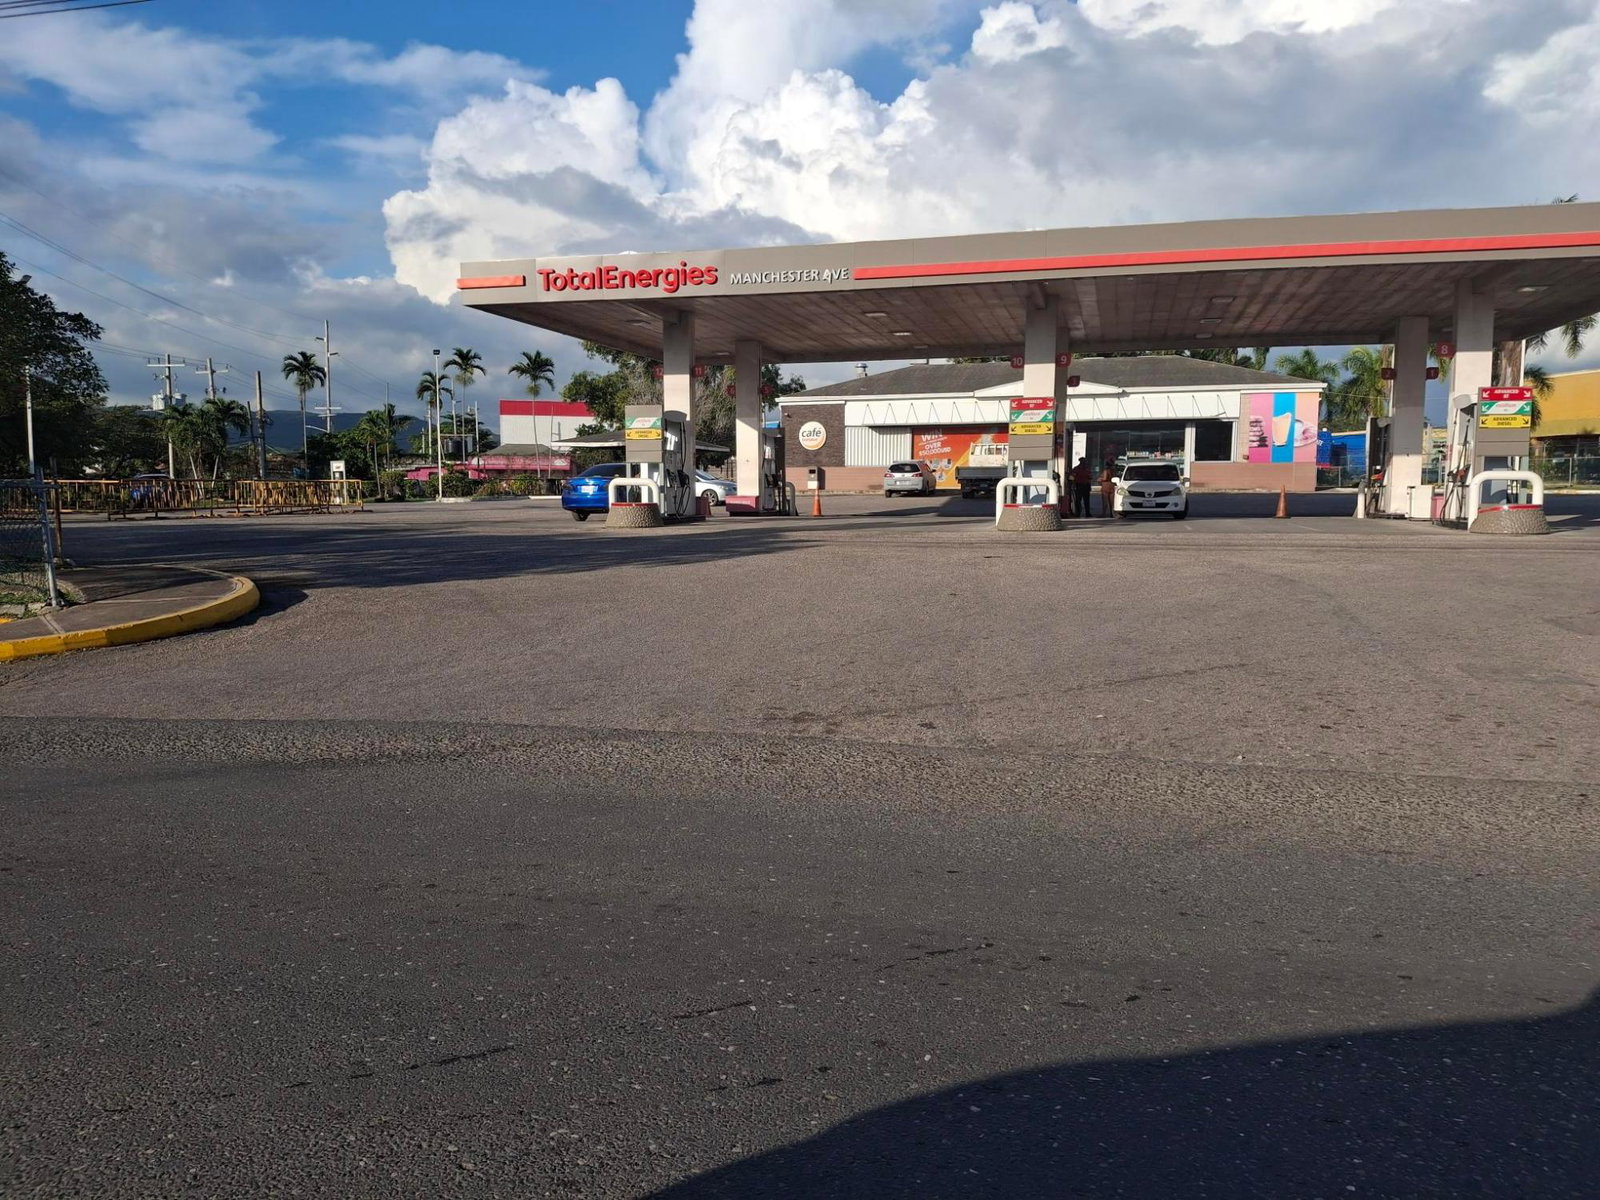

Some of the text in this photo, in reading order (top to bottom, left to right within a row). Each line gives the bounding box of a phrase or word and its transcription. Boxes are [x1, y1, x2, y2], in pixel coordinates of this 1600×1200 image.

[537, 260, 718, 293] TotalEnergies
[730, 267, 849, 285] MANCHESTER AVE
[1441, 344, 1449, 355] 8
[1013, 357, 1024, 366] 10
[1060, 355, 1067, 365] 9
[695, 367, 702, 376] 11
[801, 427, 822, 438] café
[921, 428, 943, 442] WIN
[924, 441, 941, 450] OVER
